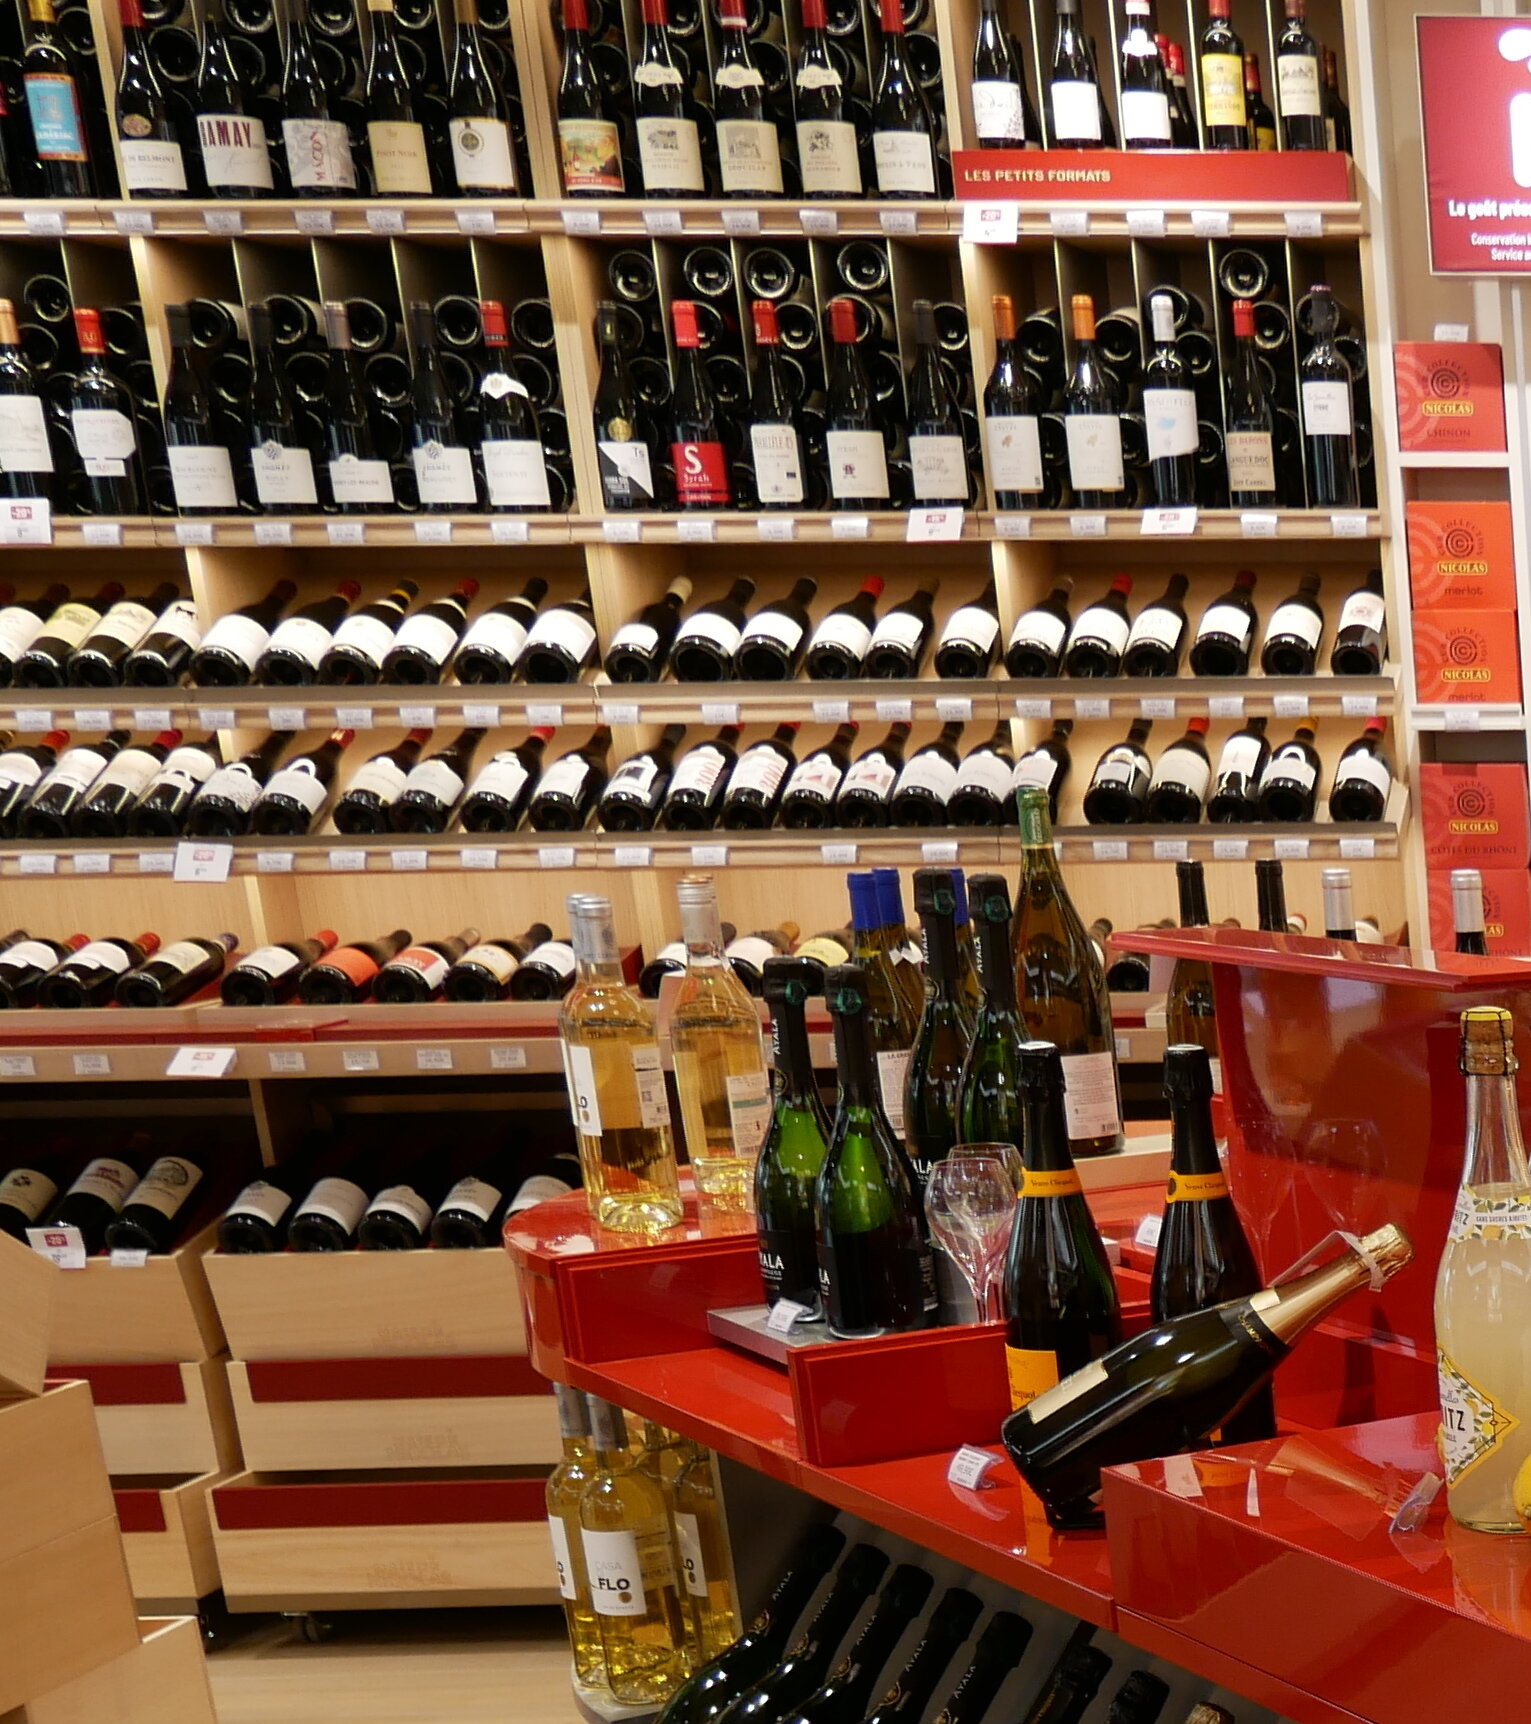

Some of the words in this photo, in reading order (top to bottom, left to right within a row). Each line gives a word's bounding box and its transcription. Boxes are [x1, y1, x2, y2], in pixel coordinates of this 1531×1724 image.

[964, 169, 991, 183] LES
[995, 169, 1045, 183] PETITS
[1048, 169, 1112, 183] FORMATS
[1449, 200, 1466, 218] Le
[1468, 200, 1498, 220] goût
[1471, 233, 1526, 245] Conservation
[1491, 248, 1523, 261] Service
[1424, 402, 1472, 415] NICOLAS
[1440, 562, 1486, 574] NICOLAS
[1444, 586, 1484, 596] merlot
[1443, 670, 1489, 681] NICOLAS
[1451, 822, 1497, 833] NICOLAS
[921, 927, 930, 963] AYALA
[976, 936, 985, 972] AYALA
[772, 1018, 782, 1056] AYALA
[1444, 1409, 1467, 1433] ITZ
[600, 1576, 631, 1591] FLO
[773, 1570, 793, 1600] AYALA
[813, 1592, 834, 1622] AYALA
[856, 1614, 877, 1646] AYALA
[904, 1639, 928, 1672] AYALA
[953, 1665, 977, 1699] AYALA
